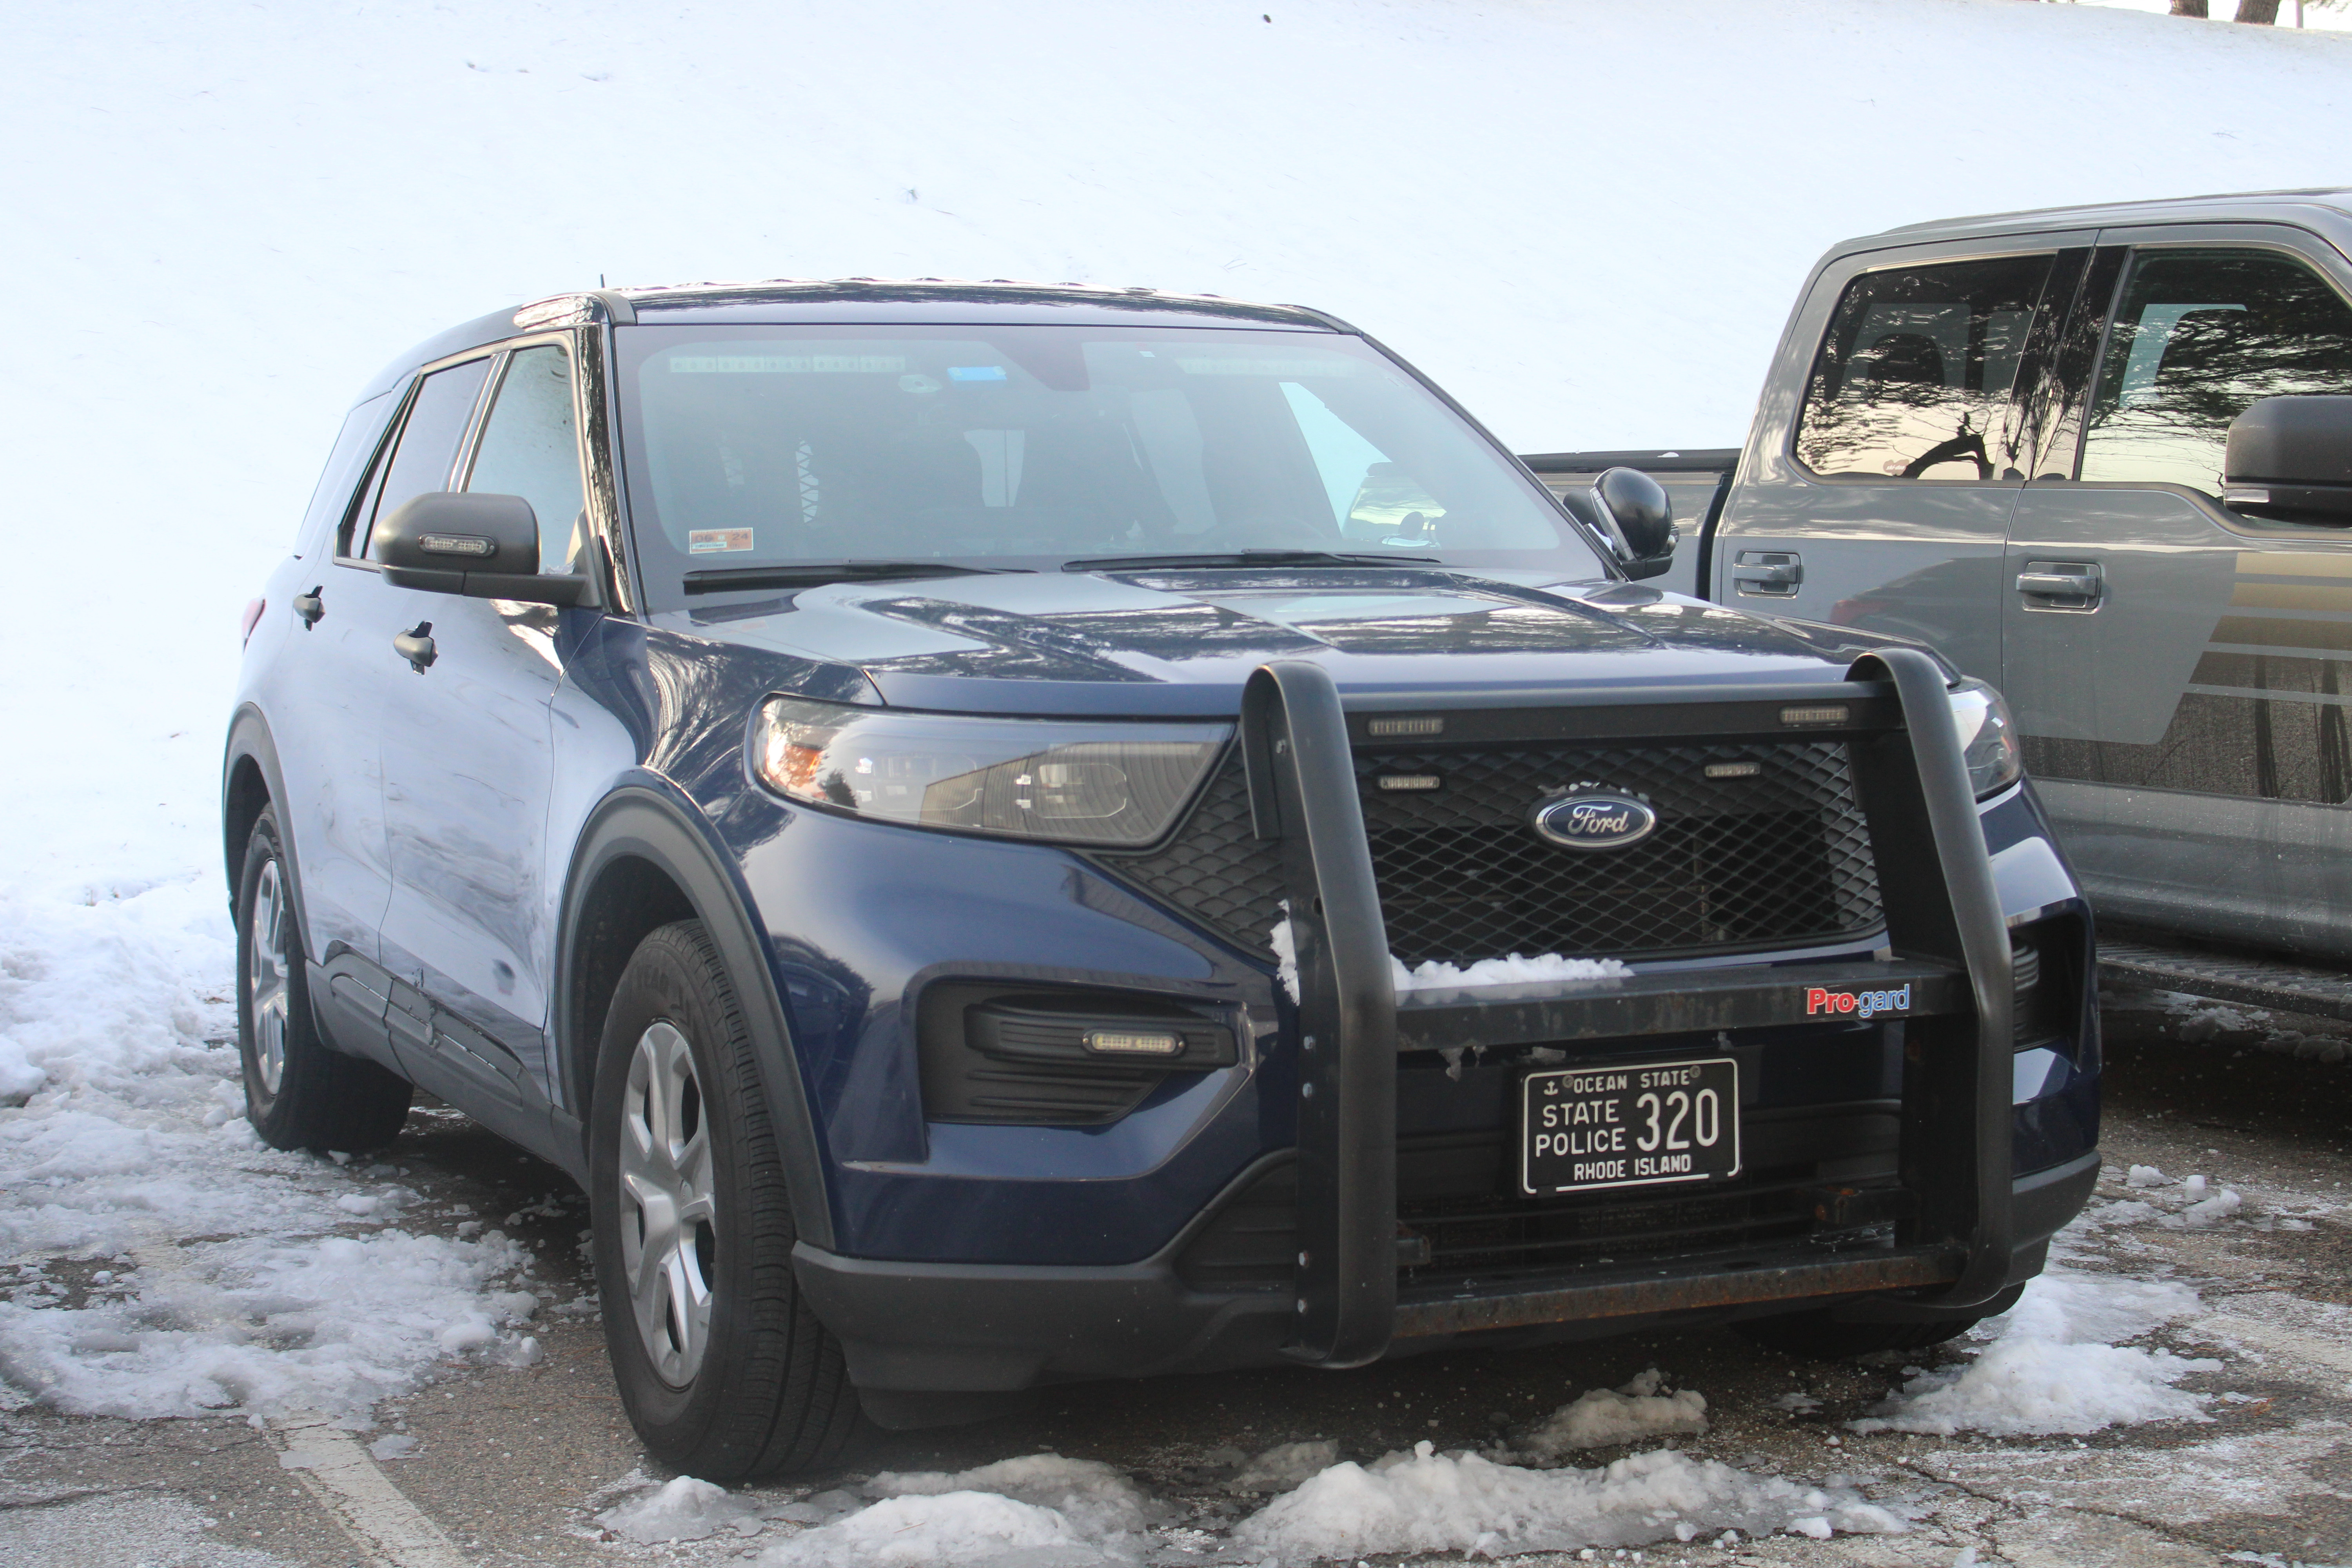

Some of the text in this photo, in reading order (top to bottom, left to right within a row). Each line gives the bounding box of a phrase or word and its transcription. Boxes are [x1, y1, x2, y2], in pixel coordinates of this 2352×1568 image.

[732, 532, 748, 541] 24
[1568, 805, 1629, 835] Ford
[1806, 983, 1910, 1018] Pro-gard
[1573, 1069, 1690, 1094] OCEAN STATE
[1543, 1099, 1620, 1128] STATE
[1636, 1088, 1719, 1152] 320
[1535, 1127, 1626, 1158] POLICE
[1574, 1154, 1692, 1181] RHODE ISLAND
